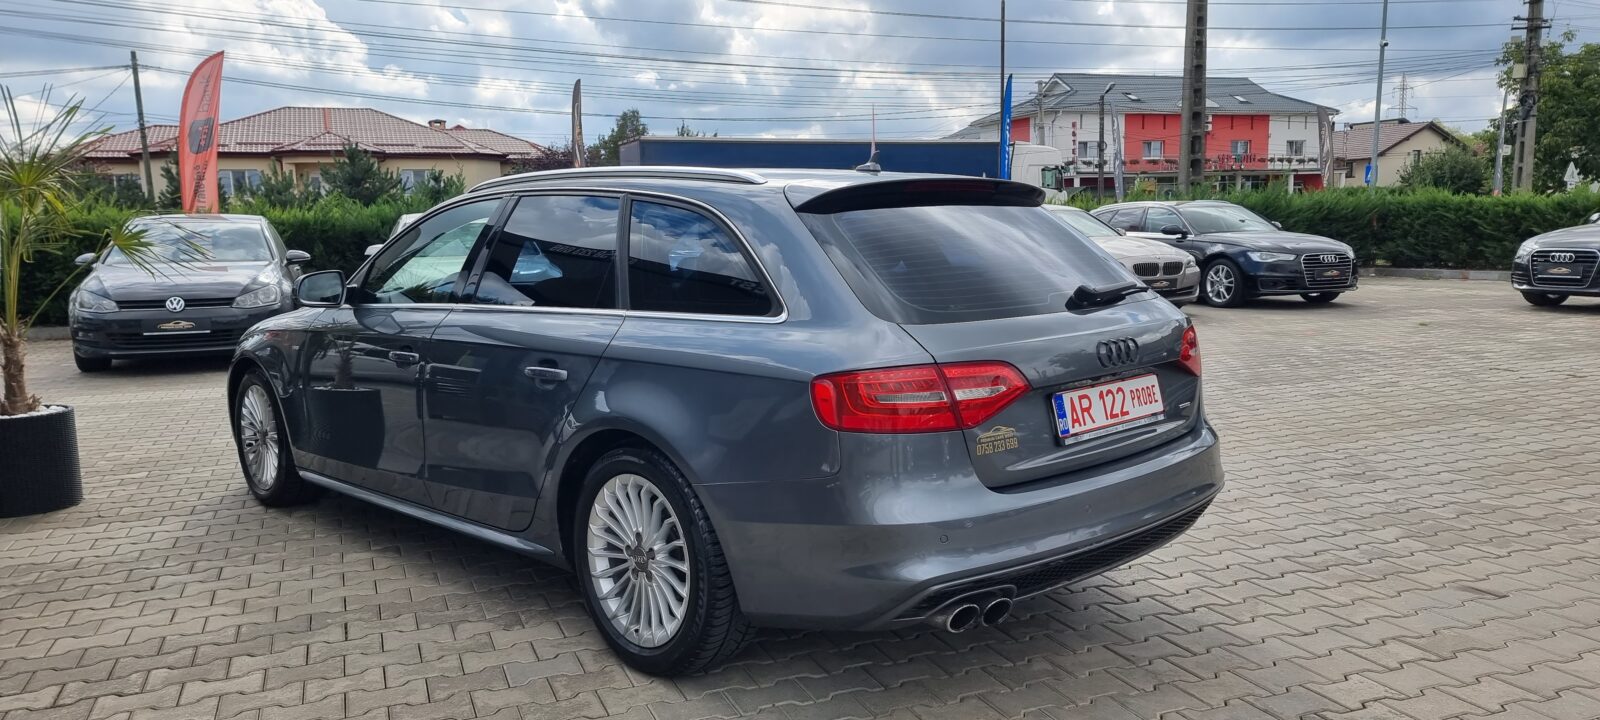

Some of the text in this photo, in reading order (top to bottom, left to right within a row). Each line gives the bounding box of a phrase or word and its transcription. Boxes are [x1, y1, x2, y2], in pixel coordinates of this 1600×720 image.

[1069, 385, 1158, 429] AR 122 PROBE
[1058, 418, 1068, 431] RO
[993, 440, 1006, 452] 233
[1005, 437, 1019, 450] 699
